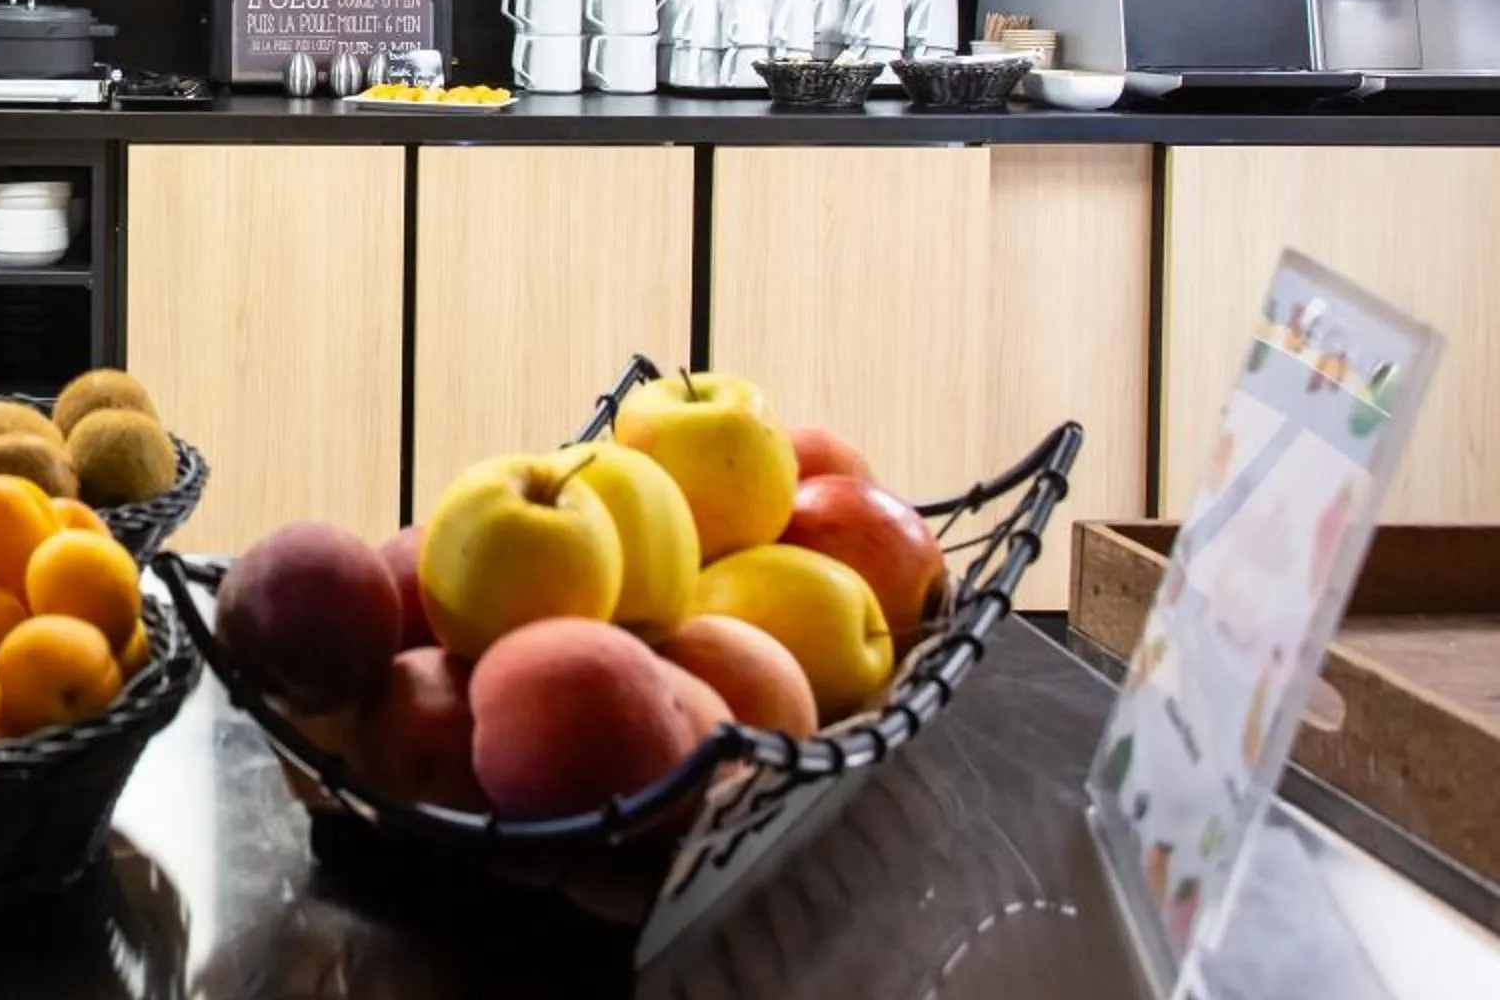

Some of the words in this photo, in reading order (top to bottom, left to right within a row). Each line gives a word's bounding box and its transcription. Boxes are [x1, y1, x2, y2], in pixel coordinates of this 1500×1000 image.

[247, 13, 275, 33] PUIS
[279, 14, 295, 33] LA
[299, 13, 336, 33] POULE
[385, 14, 393, 33] 6
[395, 14, 421, 33] MIN
